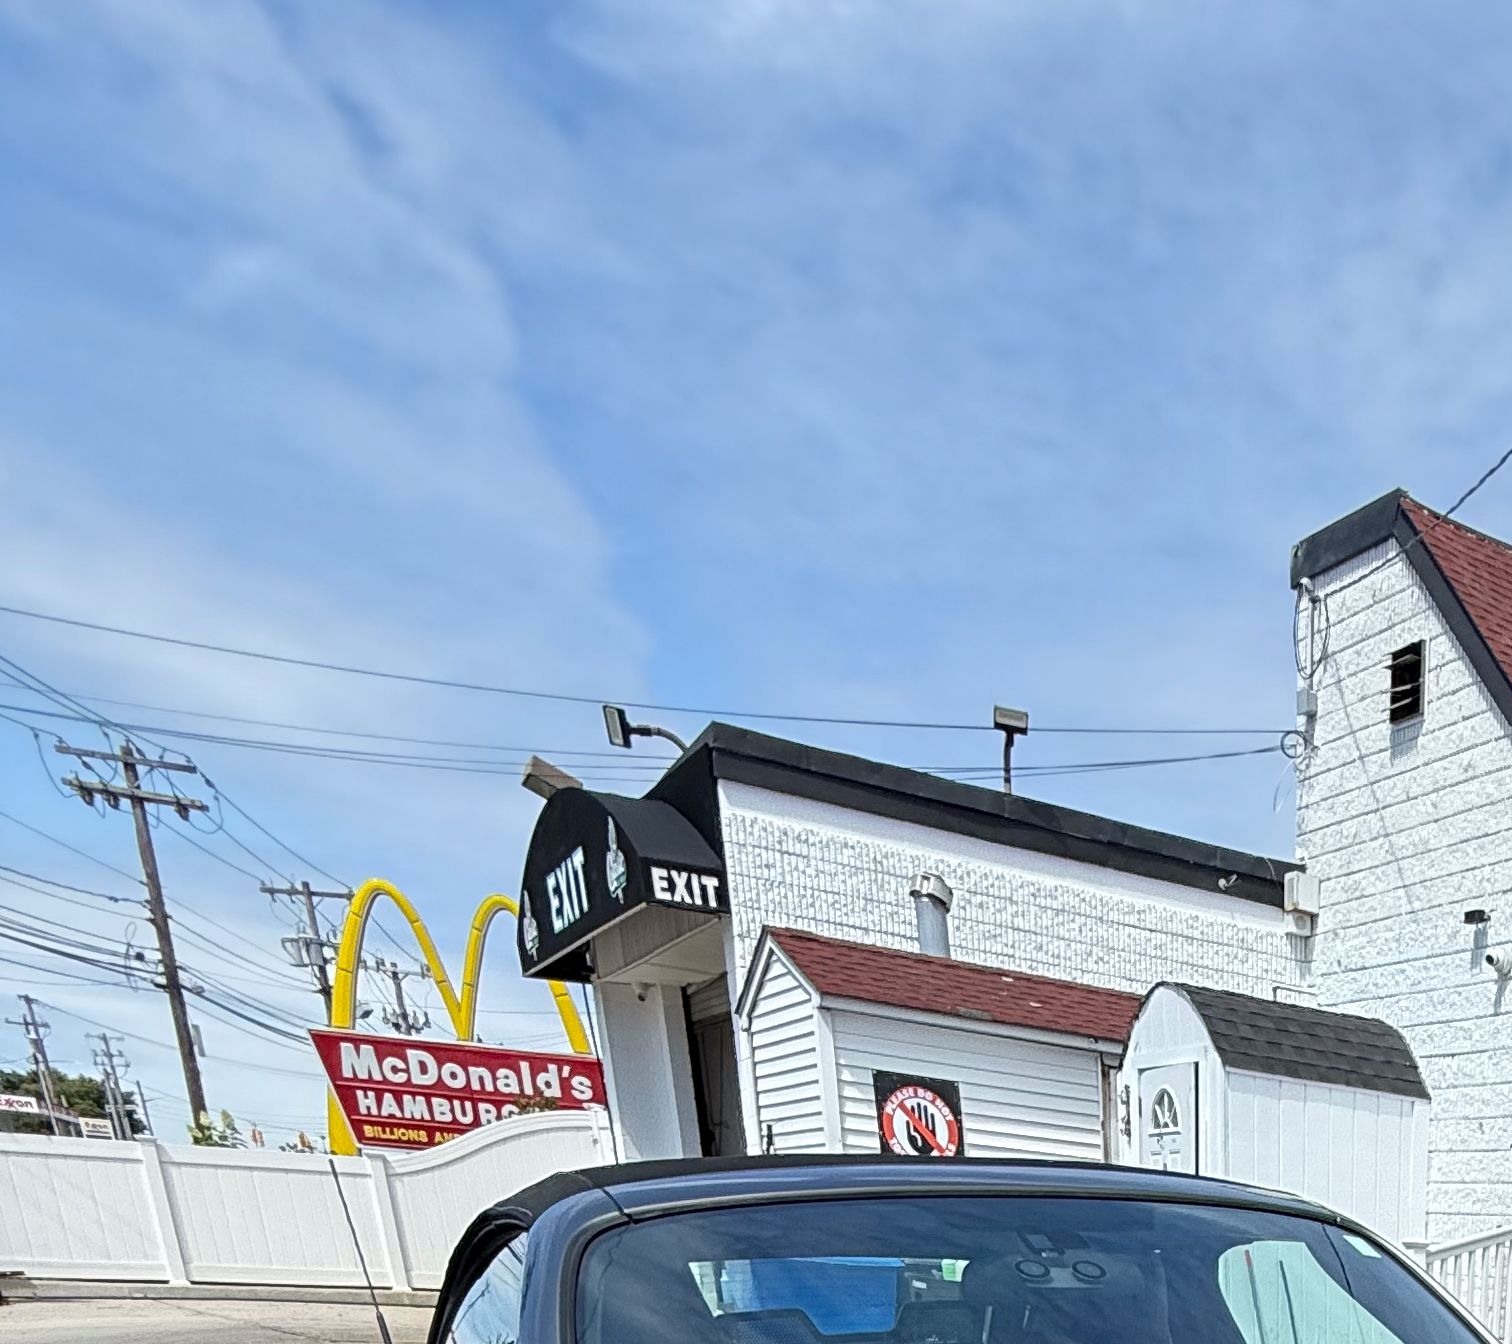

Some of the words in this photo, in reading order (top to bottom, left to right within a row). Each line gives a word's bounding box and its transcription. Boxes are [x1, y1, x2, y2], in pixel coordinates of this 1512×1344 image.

[545, 845, 589, 935] EXIT
[650, 866, 719, 908] EXIT
[339, 1041, 594, 1101] McDonald's
[355, 1089, 521, 1126] HAMBURG
[885, 1087, 915, 1115] PLEASE
[917, 1088, 933, 1101] DO
[935, 1098, 954, 1121] NOT
[363, 1124, 428, 1144] BILLIONS
[434, 1131, 462, 1144] AN
